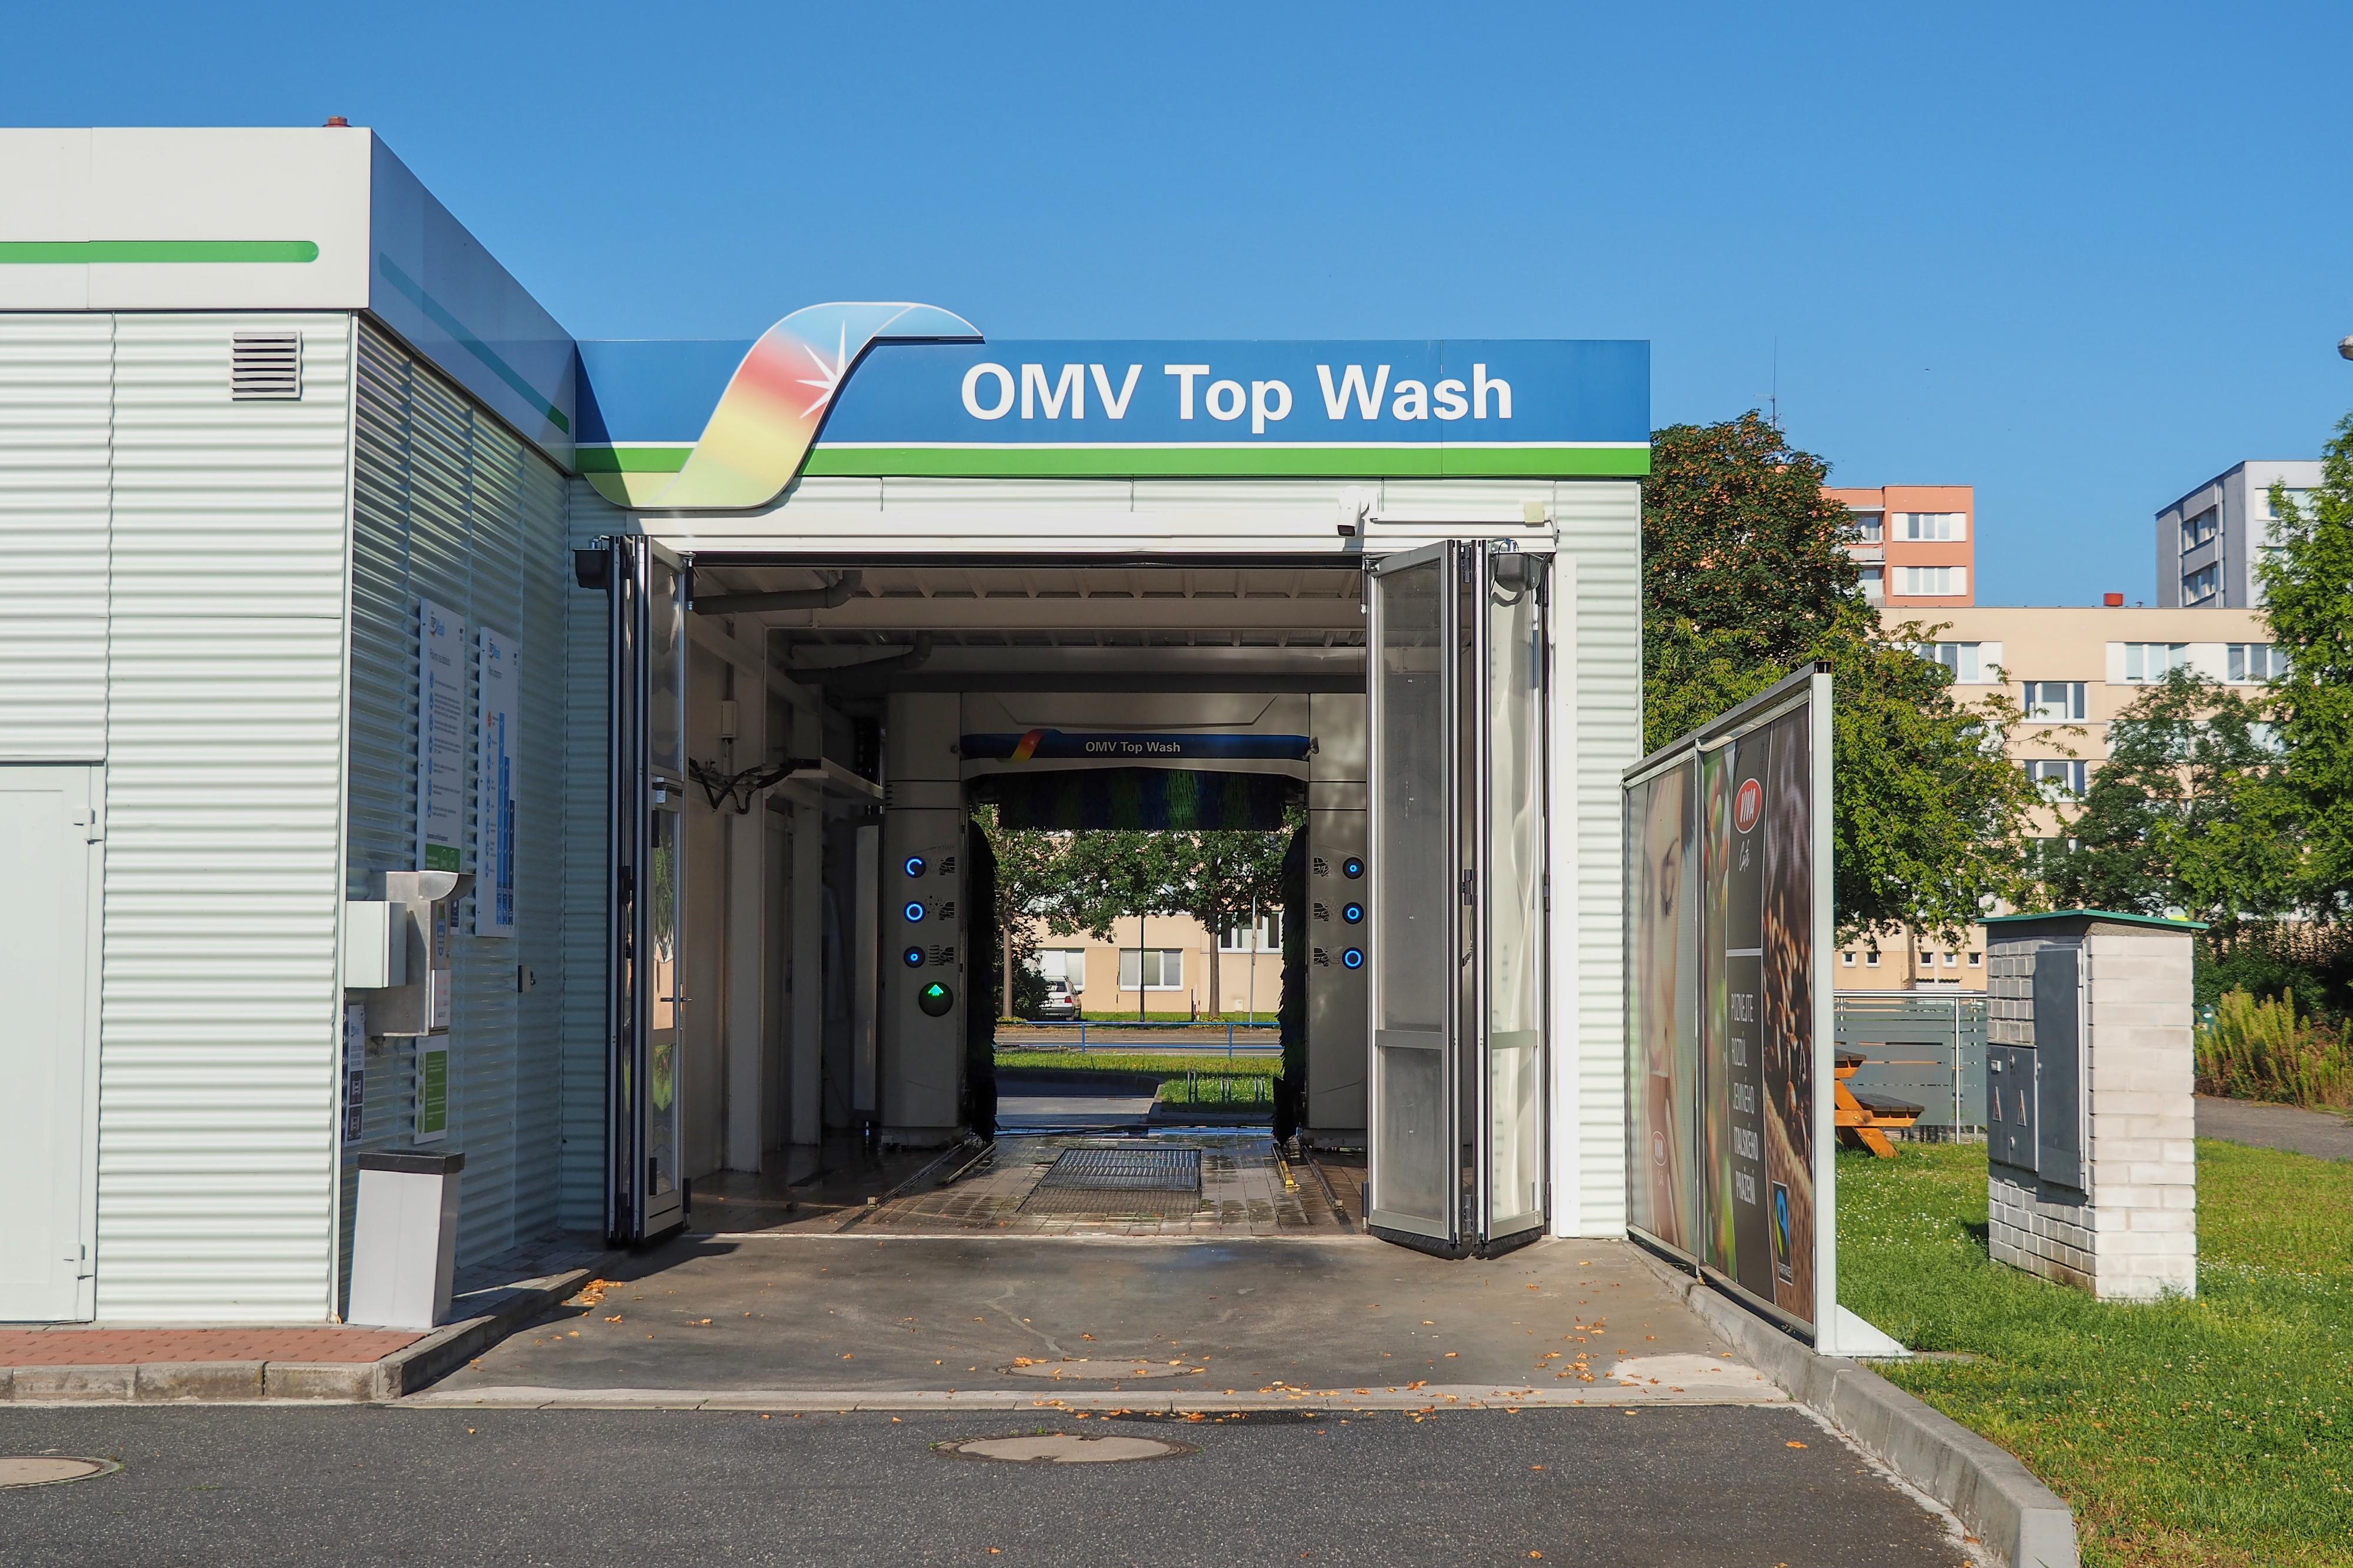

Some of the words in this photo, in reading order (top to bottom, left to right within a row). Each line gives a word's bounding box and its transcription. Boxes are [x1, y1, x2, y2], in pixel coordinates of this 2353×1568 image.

[962, 362, 1143, 421] OMV
[1164, 364, 1292, 434] Top
[1316, 363, 1512, 421] Wash
[1085, 742, 1116, 752] OMV
[1121, 742, 1142, 754] Top
[1146, 742, 1181, 752] Wash
[1740, 788, 1756, 823] VIVA
[1731, 993, 1753, 1022] POZNEJTE
[1731, 1030, 1747, 1067] ROZDÍL
[1732, 1076, 1755, 1115] JEMNÉHO
[1733, 1123, 1758, 1162] ITALSKÉHO
[1736, 1166, 1756, 1205] PRAŽENÍ
